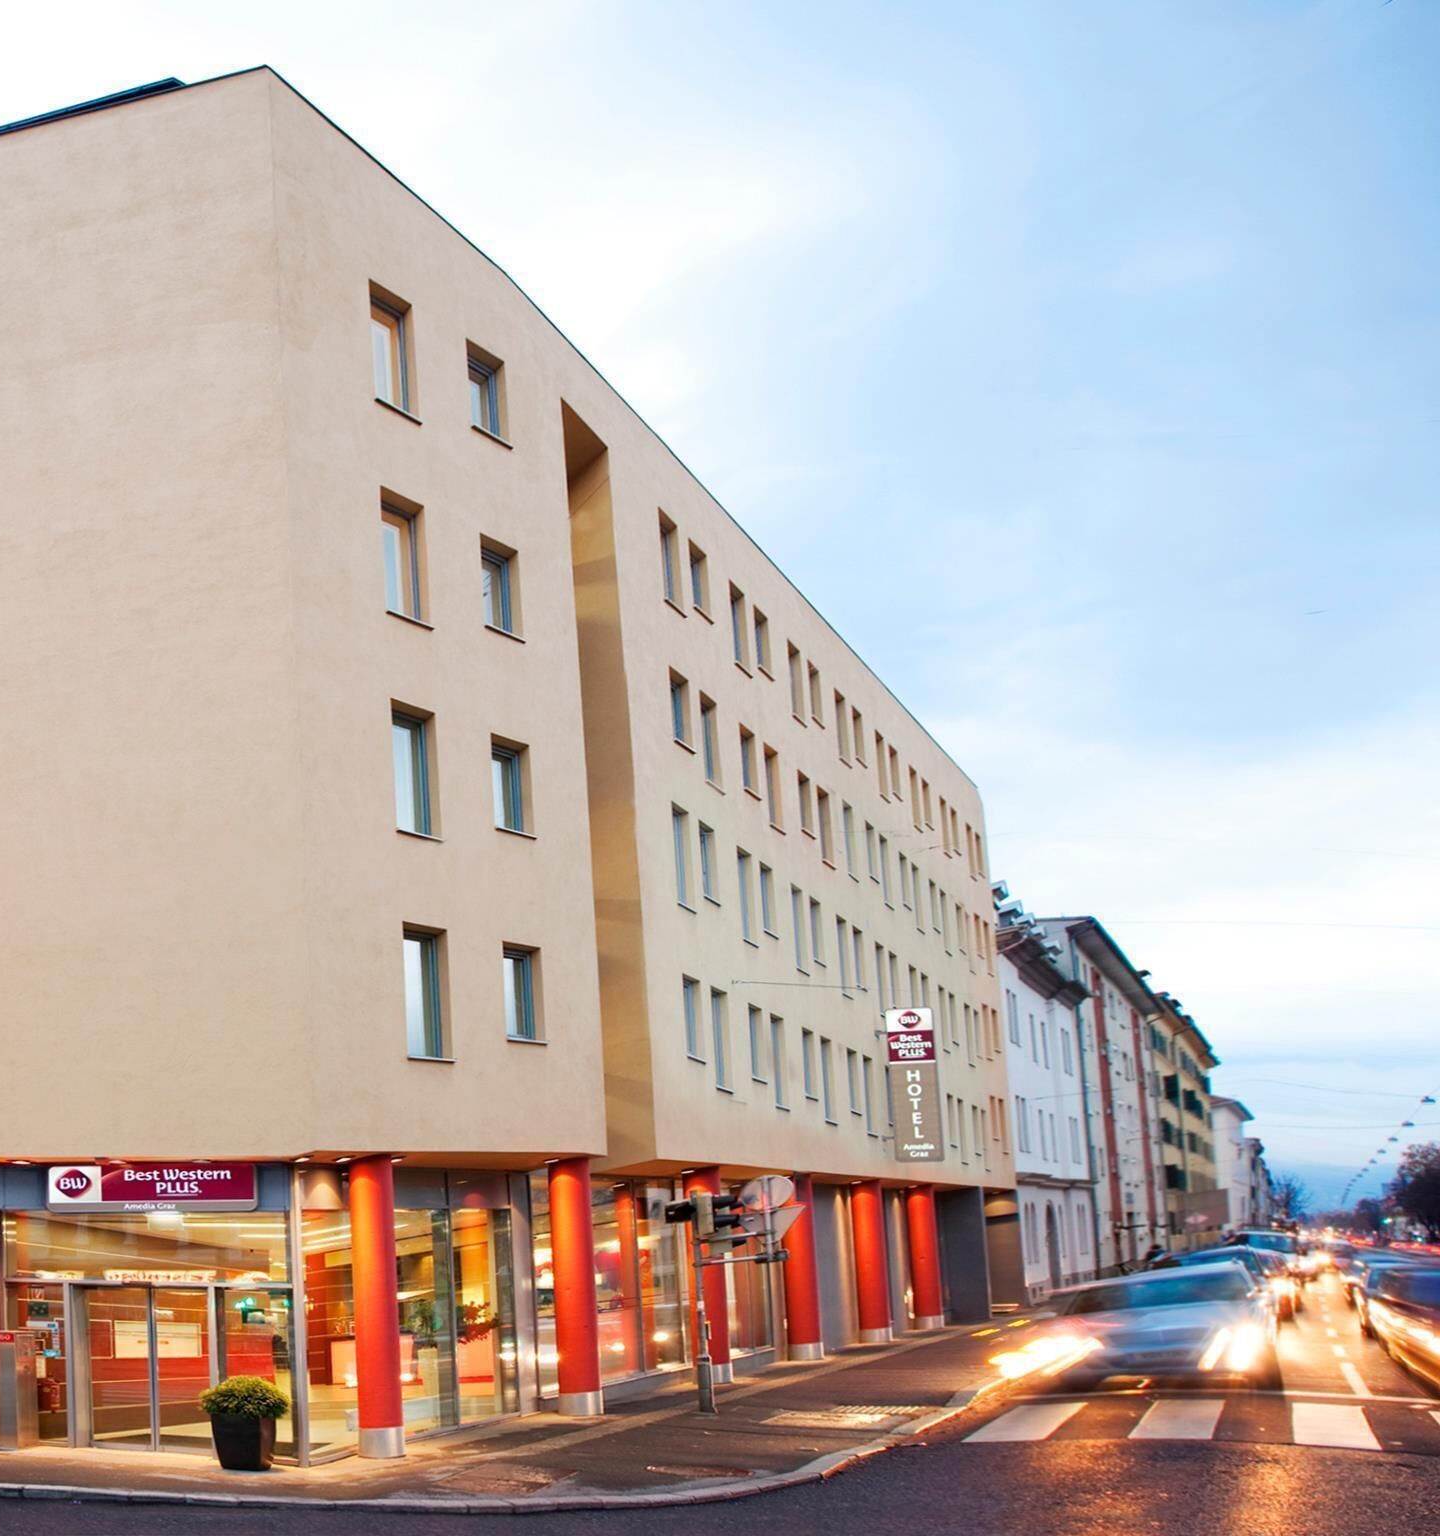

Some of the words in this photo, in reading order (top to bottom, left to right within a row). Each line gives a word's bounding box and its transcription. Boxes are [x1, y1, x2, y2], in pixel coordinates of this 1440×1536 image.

[900, 1015, 919, 1025] BW
[899, 1034, 922, 1042] Best
[890, 1041, 932, 1050] Western
[906, 1070, 924, 1139] HOTEL
[903, 1143, 935, 1151] Amedia
[124, 1169, 160, 1181] Best
[164, 1169, 231, 1180] Western
[60, 1177, 87, 1190] BW
